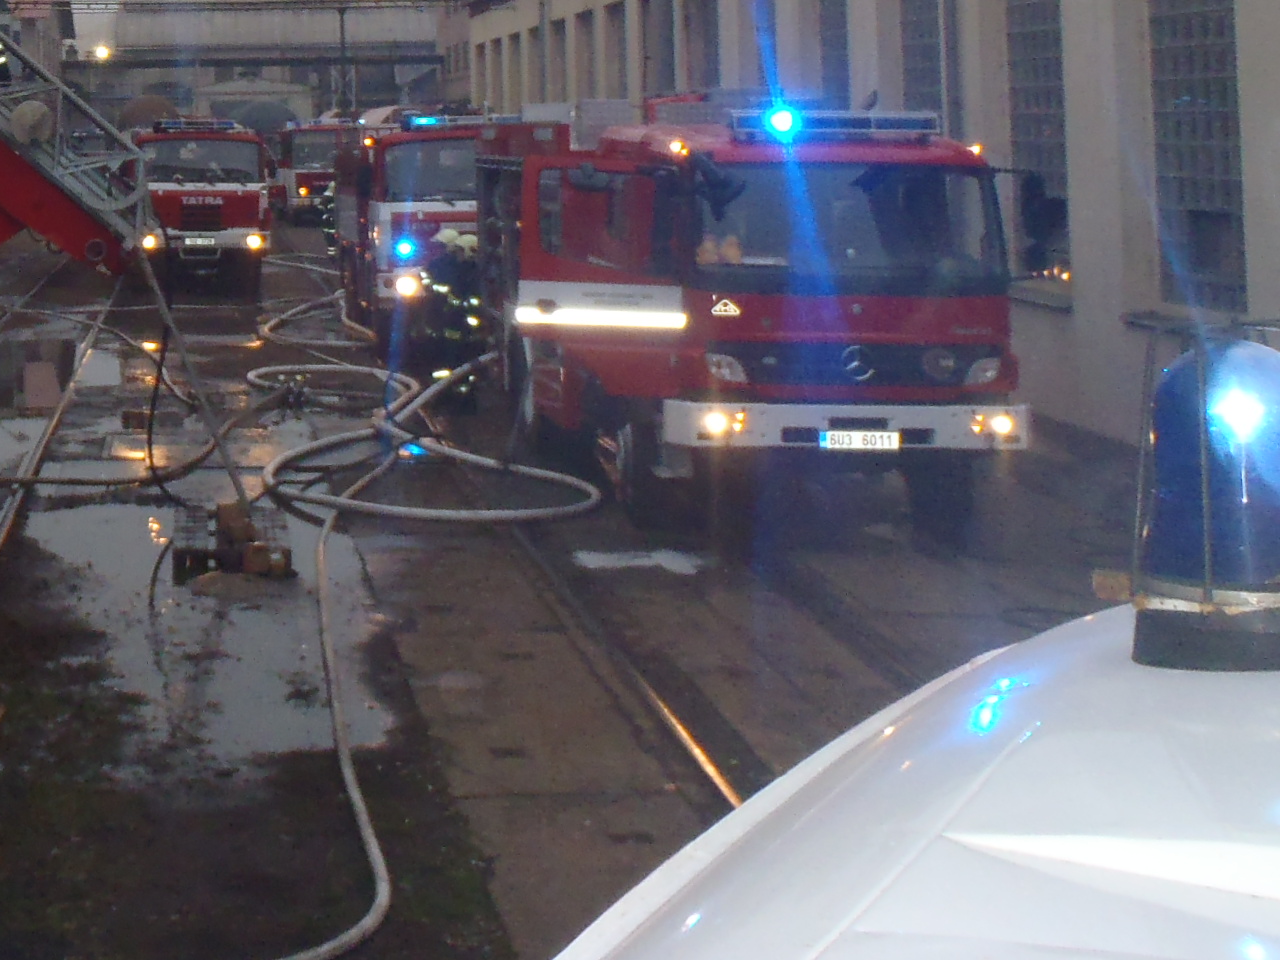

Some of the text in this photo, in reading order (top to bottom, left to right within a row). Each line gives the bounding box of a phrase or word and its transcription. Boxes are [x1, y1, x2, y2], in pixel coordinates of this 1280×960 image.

[181, 196, 223, 205] TATRA
[830, 433, 892, 447] 6U3 6011
